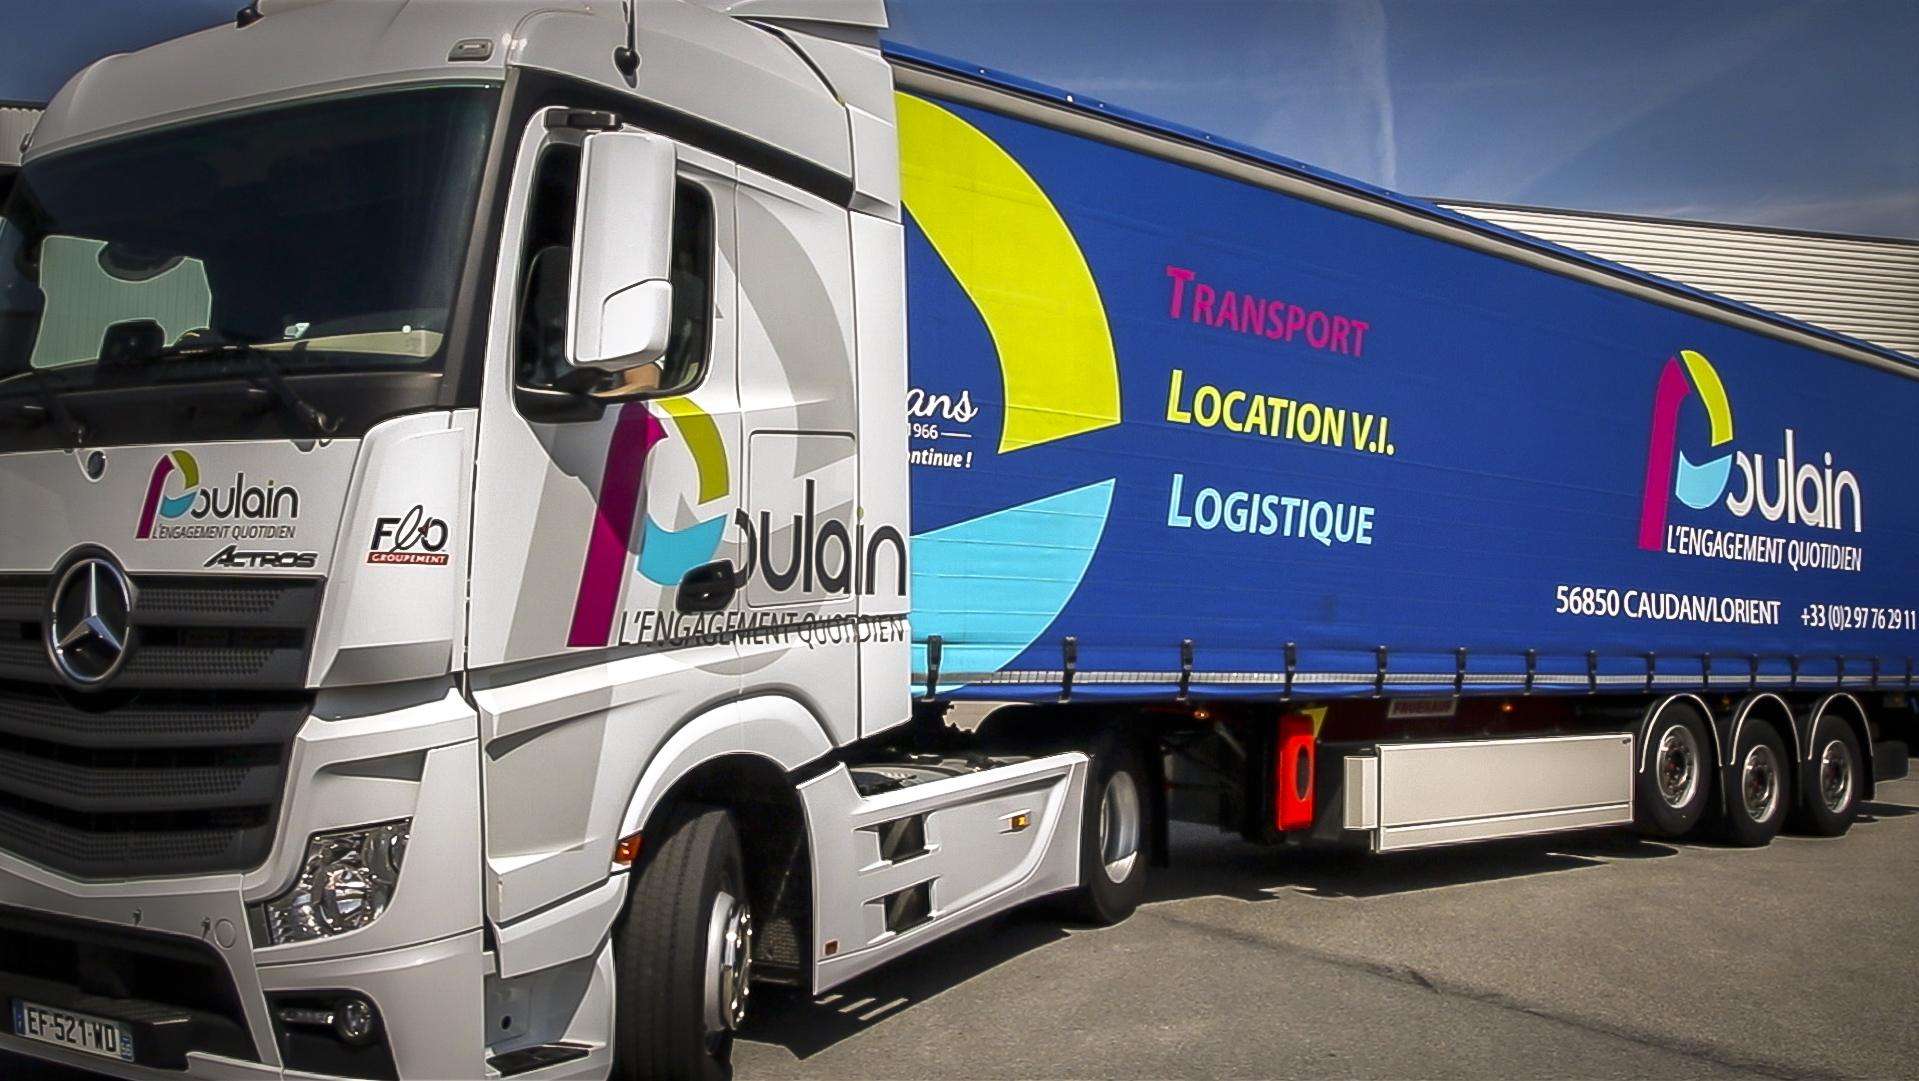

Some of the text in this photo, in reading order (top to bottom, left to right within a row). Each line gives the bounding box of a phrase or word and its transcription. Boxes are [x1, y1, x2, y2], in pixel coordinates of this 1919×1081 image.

[1166, 369, 1395, 456] LOCATION V.I.
[1167, 473, 1375, 546] LOGISTIQUE
[152, 524, 296, 540] L'ENGAGEMENT QUOTIDIEN
[1666, 524, 1863, 572] L'ENGAGEMENT QUOTIDIEN
[203, 544, 318, 568] ACTROS
[1555, 585, 1781, 625] 56850 CAUDAN/LORIENT
[1800, 604, 1827, 627] +33
[1853, 606, 1869, 629] 97
[1870, 607, 1886, 629] 76
[1887, 608, 1902, 630] 29
[1903, 609, 1916, 631] 11
[618, 610, 797, 646] L'ENGAGEMENT
[27, 1006, 118, 1053] EF-521-WD
